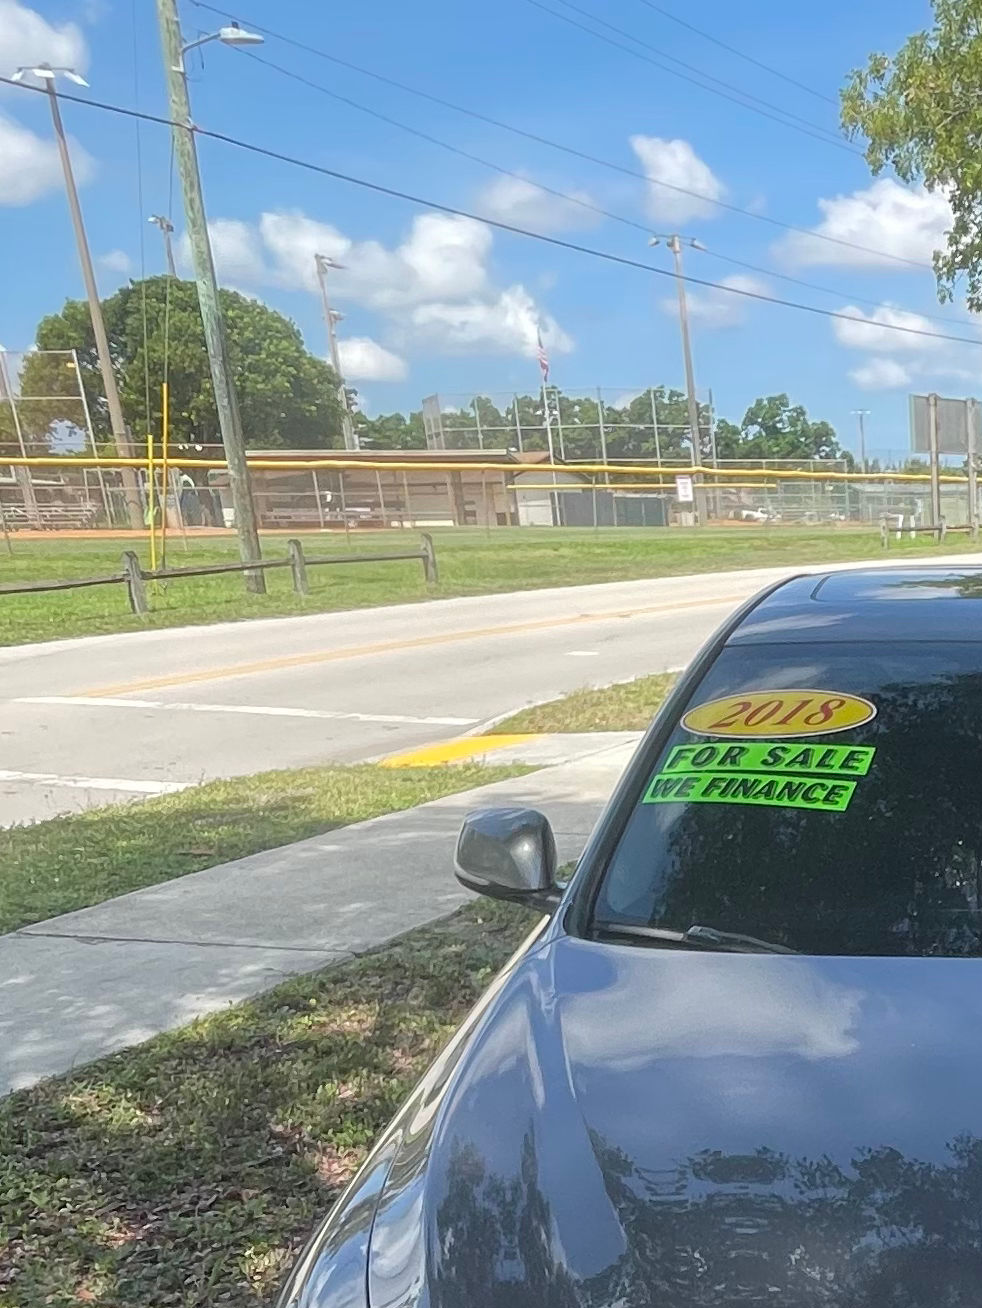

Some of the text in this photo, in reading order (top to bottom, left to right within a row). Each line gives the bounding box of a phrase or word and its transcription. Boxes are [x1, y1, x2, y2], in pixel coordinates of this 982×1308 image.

[707, 698, 847, 729] 2018
[666, 745, 870, 772] FOR SALE
[650, 776, 850, 805] WE FINANCE
